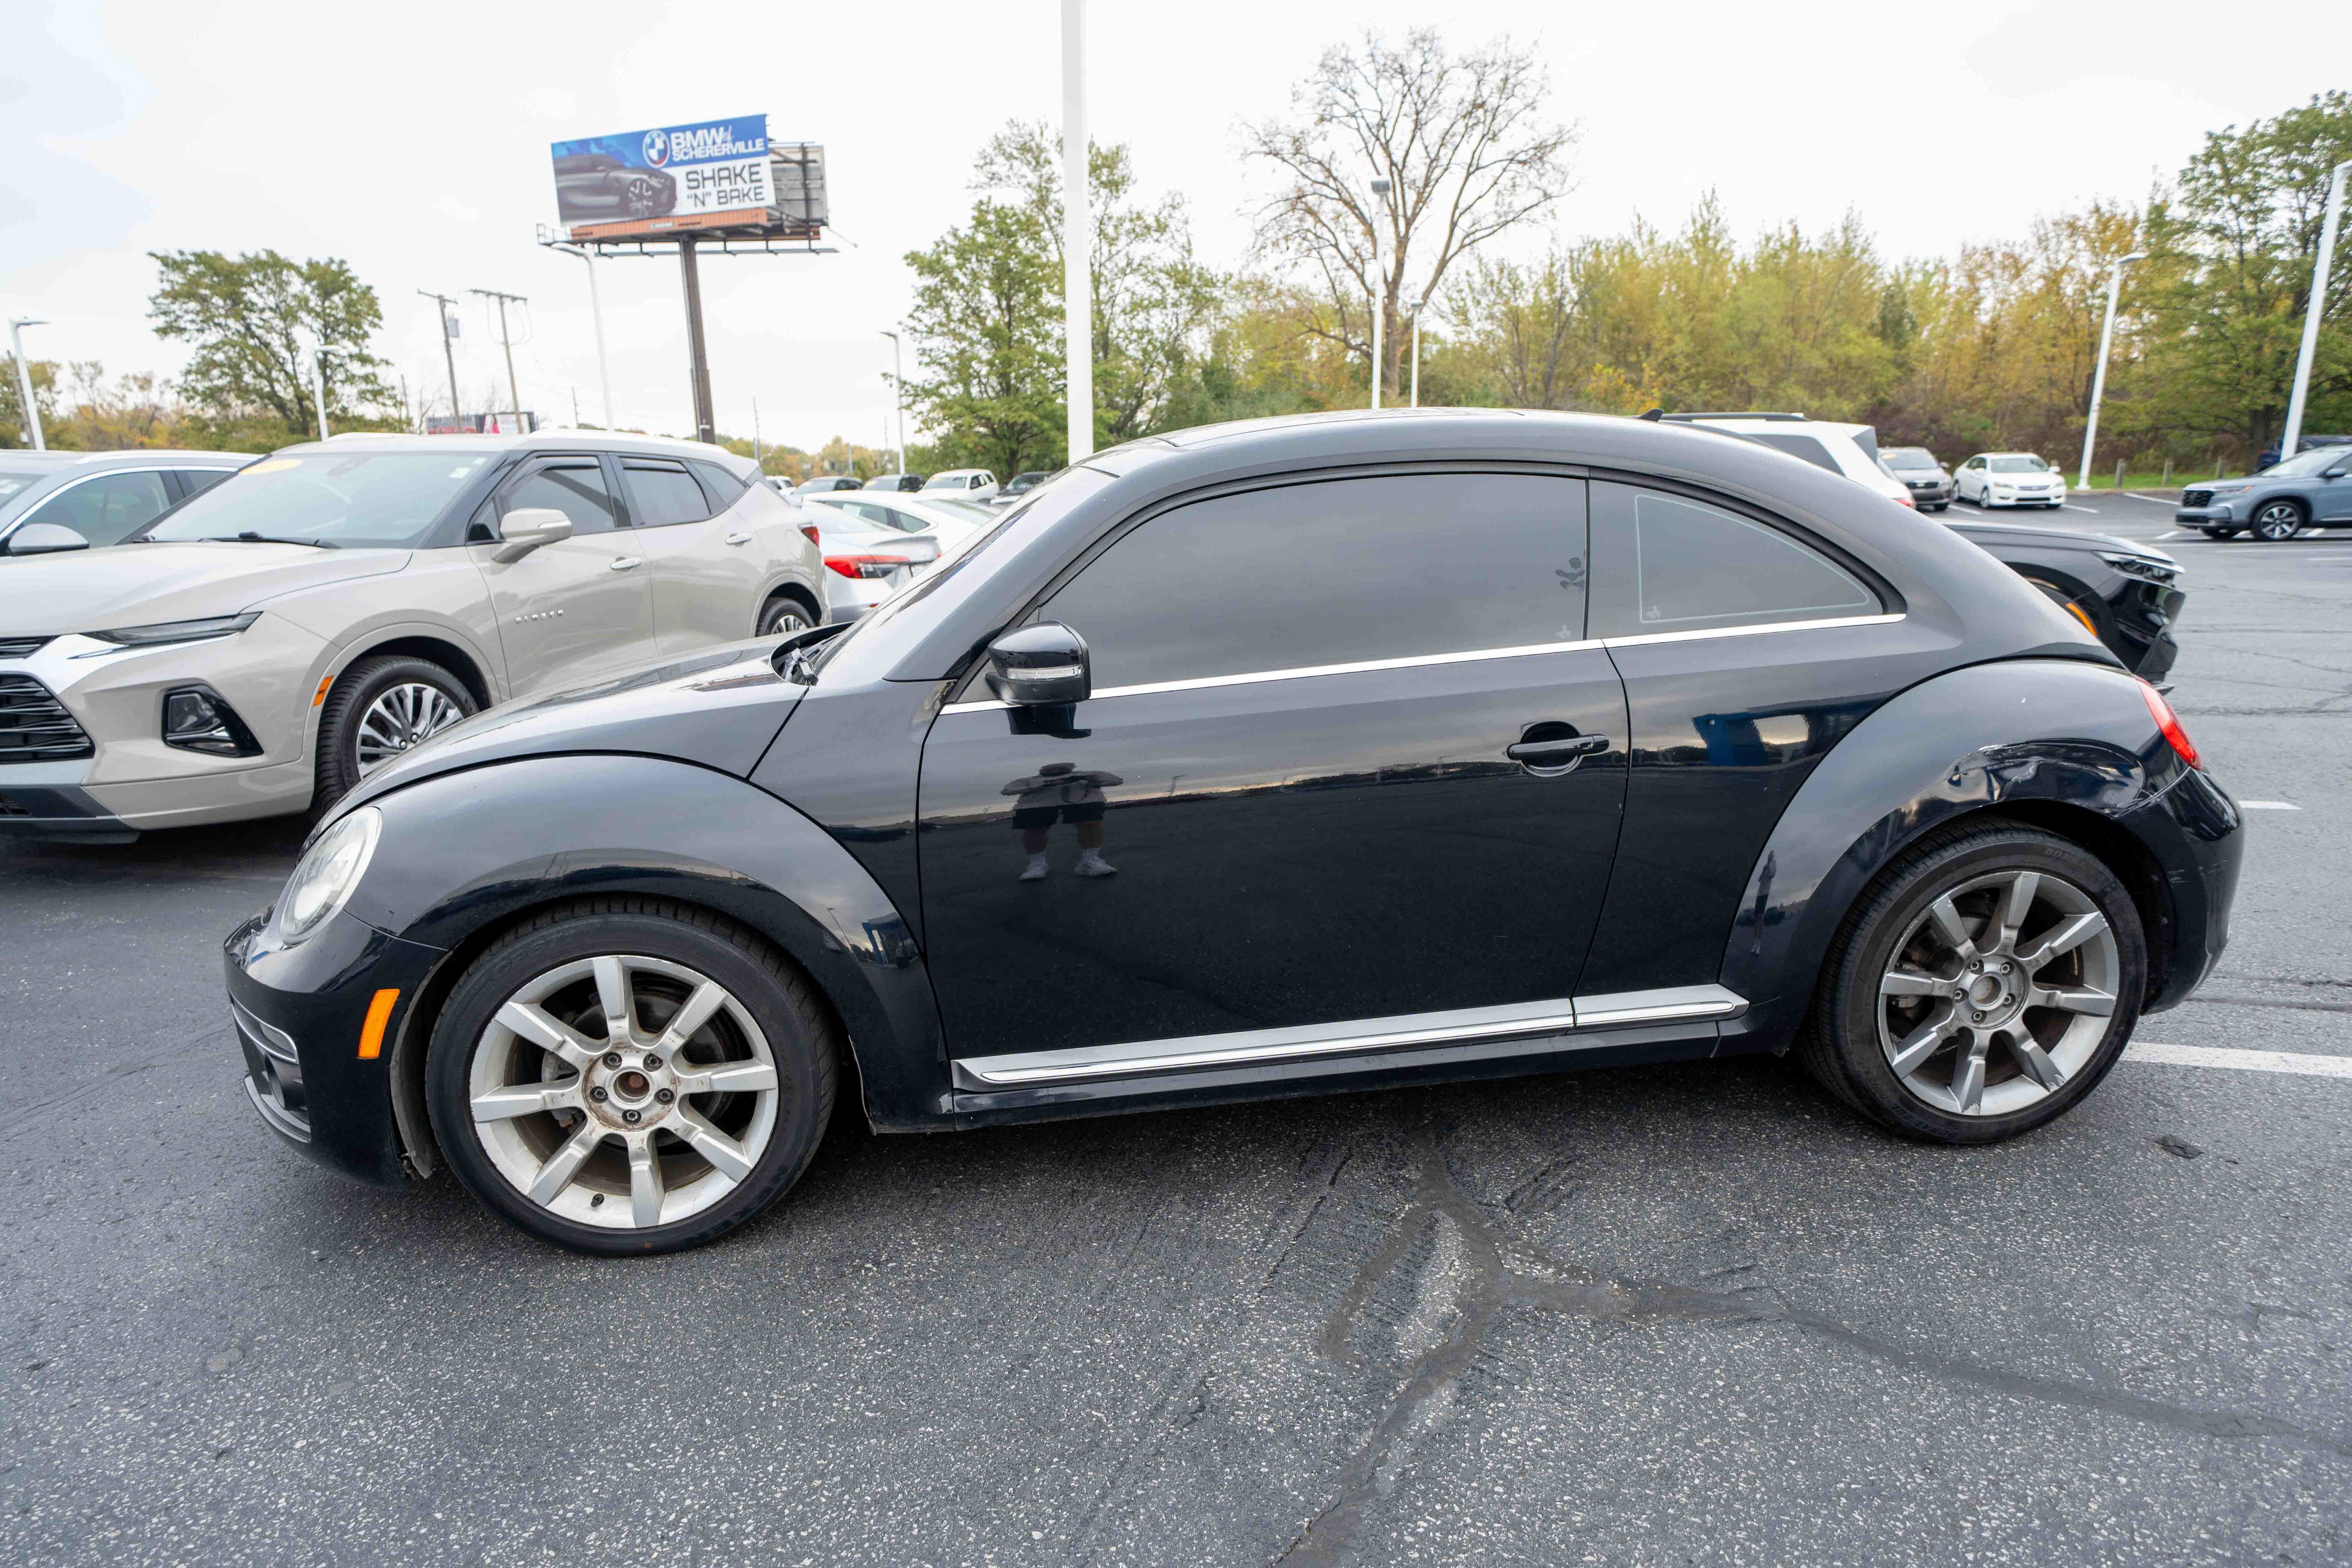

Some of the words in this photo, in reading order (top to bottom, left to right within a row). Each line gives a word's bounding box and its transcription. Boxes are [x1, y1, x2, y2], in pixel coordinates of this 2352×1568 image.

[670, 126, 725, 150] BMW
[672, 138, 764, 162] SCHERERVILLE
[686, 163, 762, 189] SHAKE
[717, 185, 765, 205] BAKE
